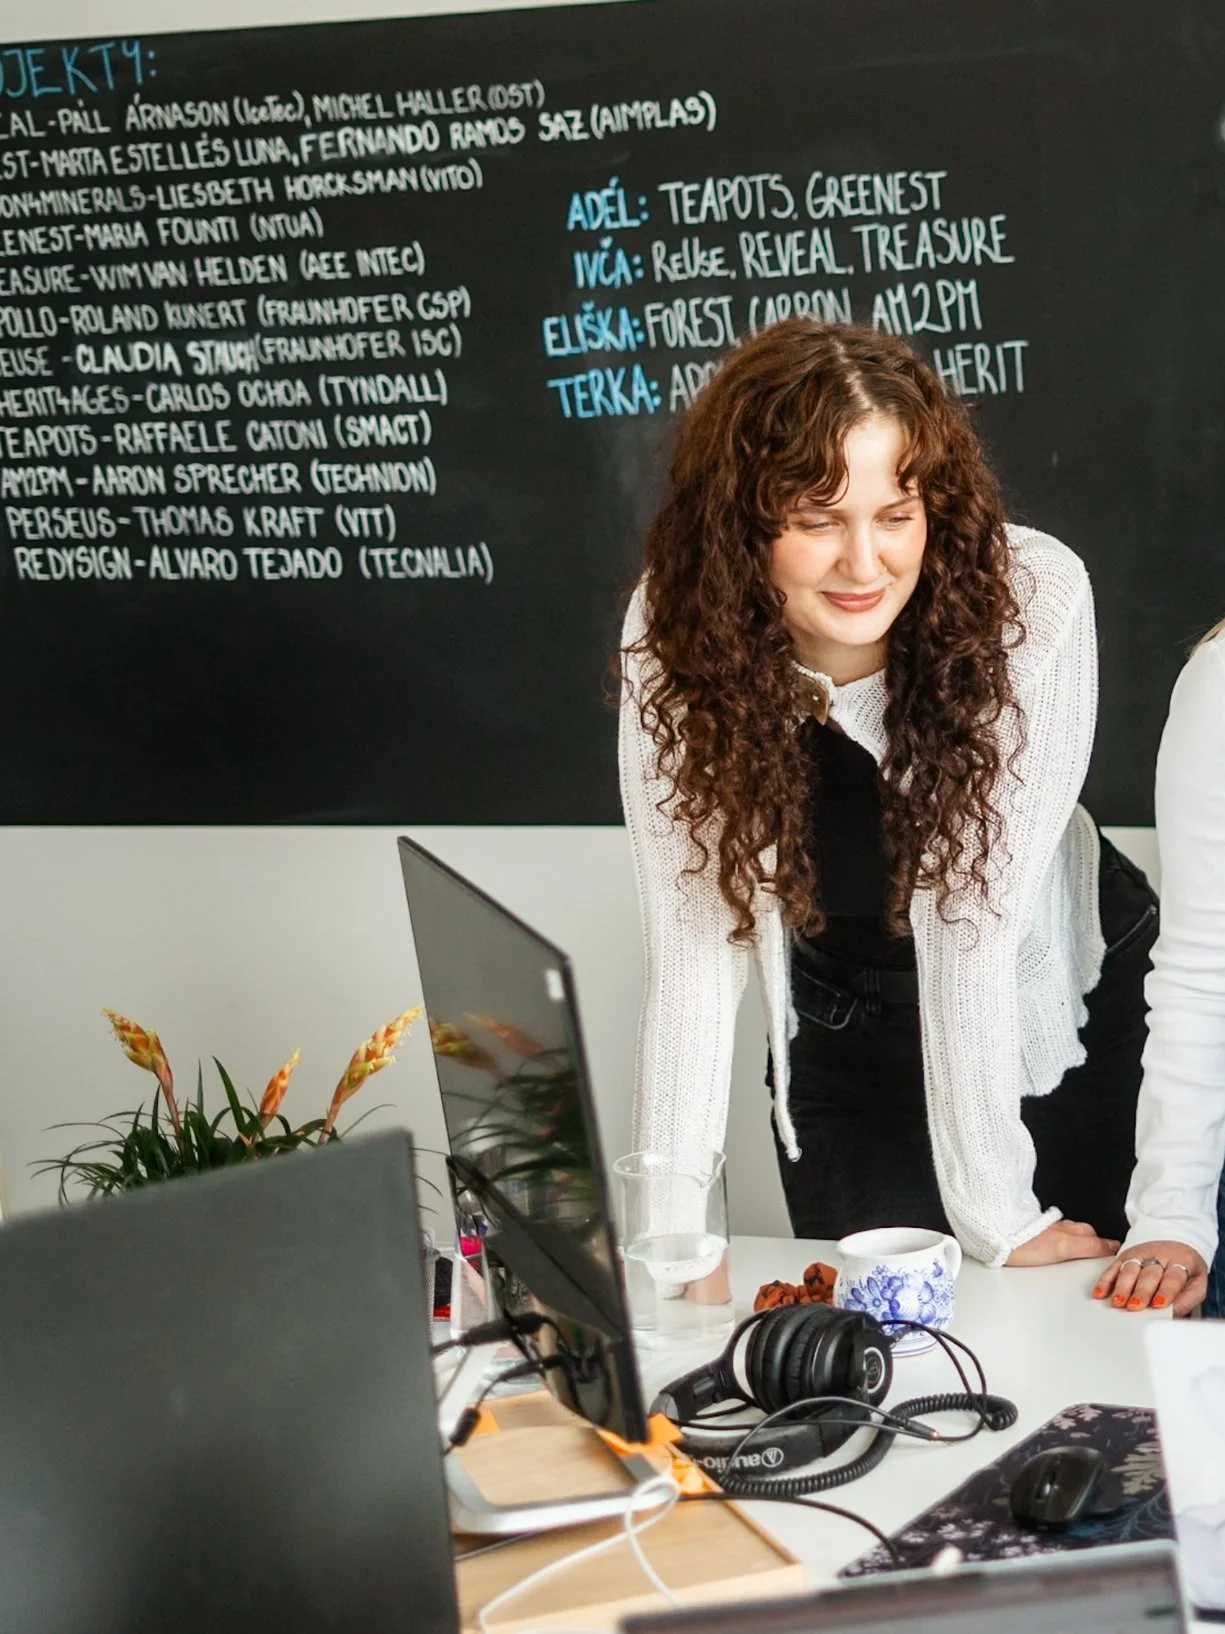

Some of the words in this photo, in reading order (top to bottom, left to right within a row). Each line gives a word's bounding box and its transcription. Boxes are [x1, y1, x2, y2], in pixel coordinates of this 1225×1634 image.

[0, 40, 156, 98] JEKTY:
[125, 92, 230, 132] ÁRNASON
[312, 92, 394, 122] MICHEL
[396, 85, 487, 117] HALLER
[487, 79, 546, 111] (OST)
[110, 132, 231, 176] ESTELLÉS
[300, 120, 440, 162] FERNANDO
[449, 116, 527, 151] RAMOS
[538, 110, 591, 143] SAZ
[590, 90, 717, 140] (AIMPLAS)
[419, 158, 484, 193] (VITO)
[567, 175, 649, 231] ADÉL:
[805, 170, 948, 220] GREENEST
[157, 216, 241, 247] FOUNTI
[249, 206, 324, 243] (NTUA)
[851, 214, 1016, 273] TREASURE
[144, 260, 190, 290] VAN
[194, 254, 289, 287] HELDEN
[300, 248, 352, 281] (AEE
[355, 240, 426, 278] INTEC)
[164, 299, 248, 331] KUNERT
[256, 294, 415, 327] (FRAUNHOFER
[542, 300, 645, 358] ELIŠKA:
[872, 279, 983, 336] AM2PM
[0, 346, 54, 379] EUSE
[412, 322, 463, 359] ISC)
[237, 378, 312, 408] OCHOA
[318, 368, 449, 407] (TYNDALL)
[546, 362, 661, 419] TERKA:
[245, 419, 328, 451] CATONI
[334, 409, 432, 449] (SMACT)
[173, 462, 302, 495] SPRECHER
[310, 456, 437, 496] (TECHNION)
[243, 505, 324, 539] KRAFT
[335, 502, 397, 543] (VTT)
[243, 546, 344, 580] TEJADO
[358, 540, 494, 585] (TECNALIA)
